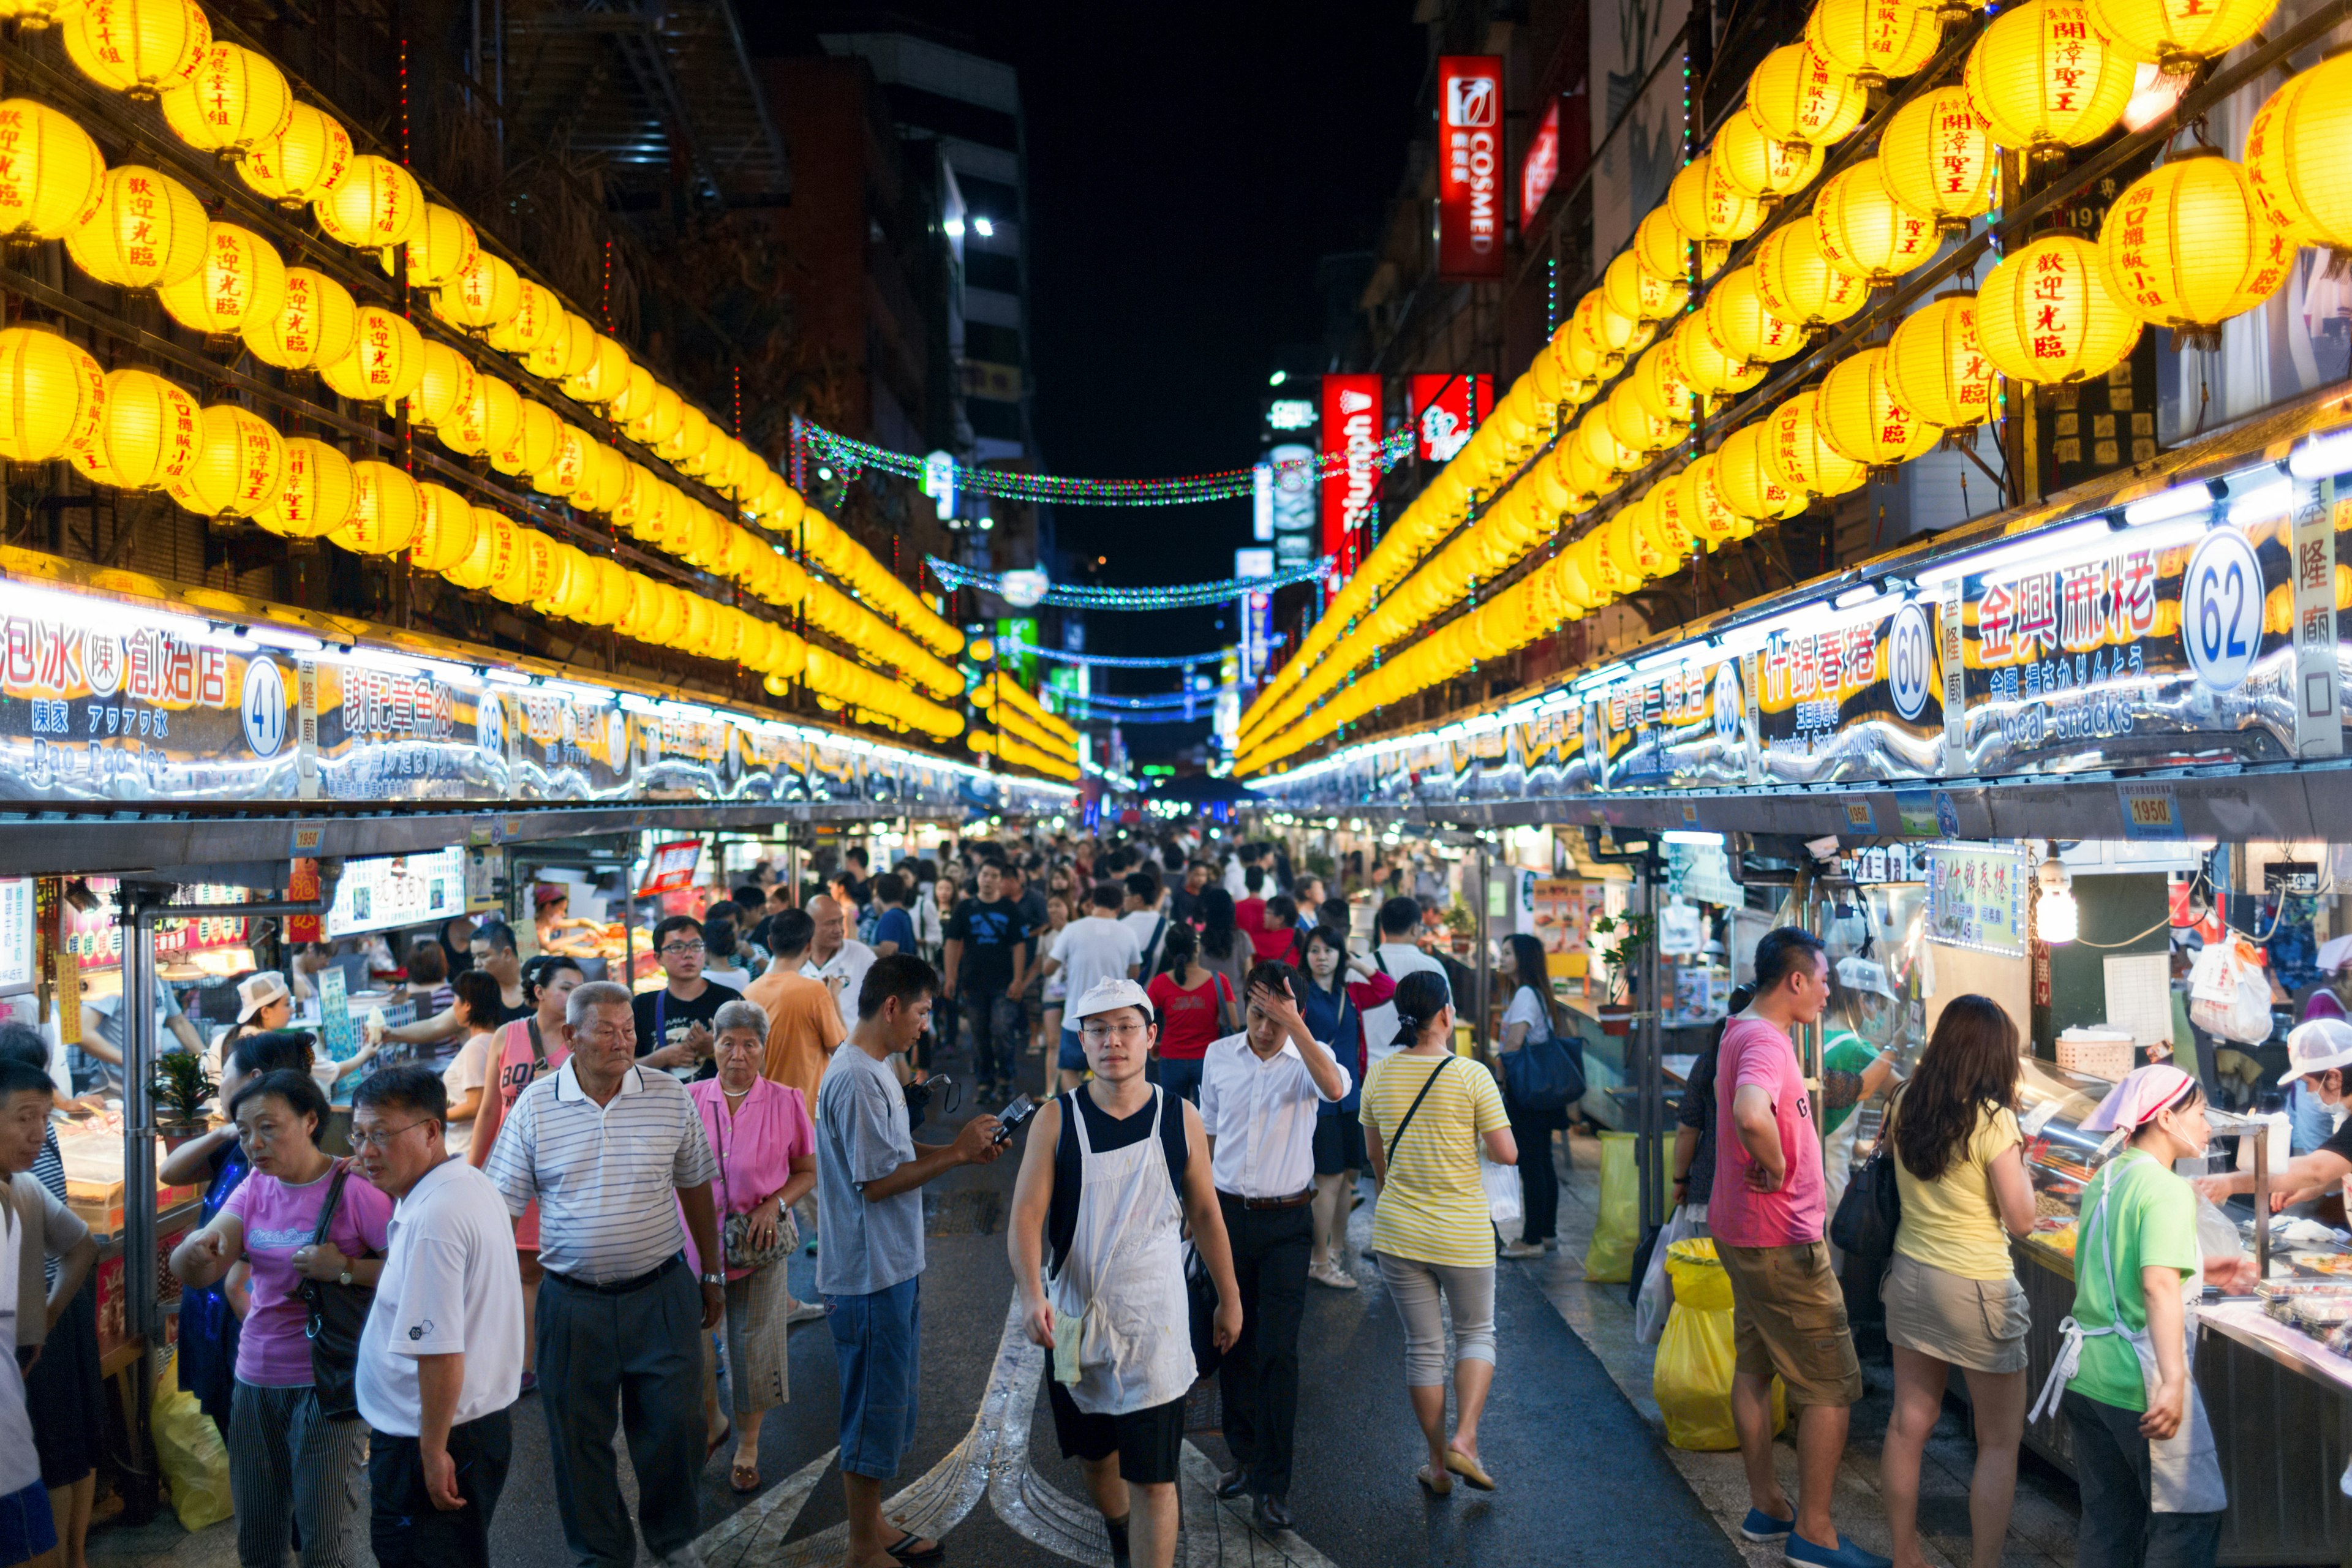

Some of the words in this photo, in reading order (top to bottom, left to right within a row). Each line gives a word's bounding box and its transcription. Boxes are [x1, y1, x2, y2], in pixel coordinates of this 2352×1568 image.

[2048, 21, 2086, 112] 開漳聖王
[1942, 114, 1972, 194] 開漳聖王
[128, 178, 157, 267] 歡迎光臨
[1470, 132, 1494, 254] COSMED
[216, 234, 242, 316] 歡迎光臨
[2034, 252, 2066, 359] 歡迎光臨
[286, 277, 309, 353] 歡迎光臨
[369, 316, 391, 385] 歡迎光臨
[241, 435, 270, 500] 開漳聖王
[2201, 559, 2246, 663] 62
[1765, 620, 1876, 703] 什錦春捲
[1899, 624, 1923, 695] 60
[1990, 666, 2019, 703] 金興
[32, 699, 69, 733] 陳家
[252, 678, 276, 739] 41
[343, 667, 453, 739] 謝記章魚腳
[484, 705, 497, 748] 39
[1720, 679, 1734, 733] 58
[2000, 703, 2045, 744] local
[2056, 696, 2133, 739] snacks
[34, 737, 75, 774] Pao
[88, 739, 127, 774] Pao
[140, 743, 167, 775] Ice
[298, 831, 317, 846] 1950
[1850, 807, 1867, 822] 1950
[2134, 800, 2166, 821] 1950
[411, 1329, 420, 1338] 66
